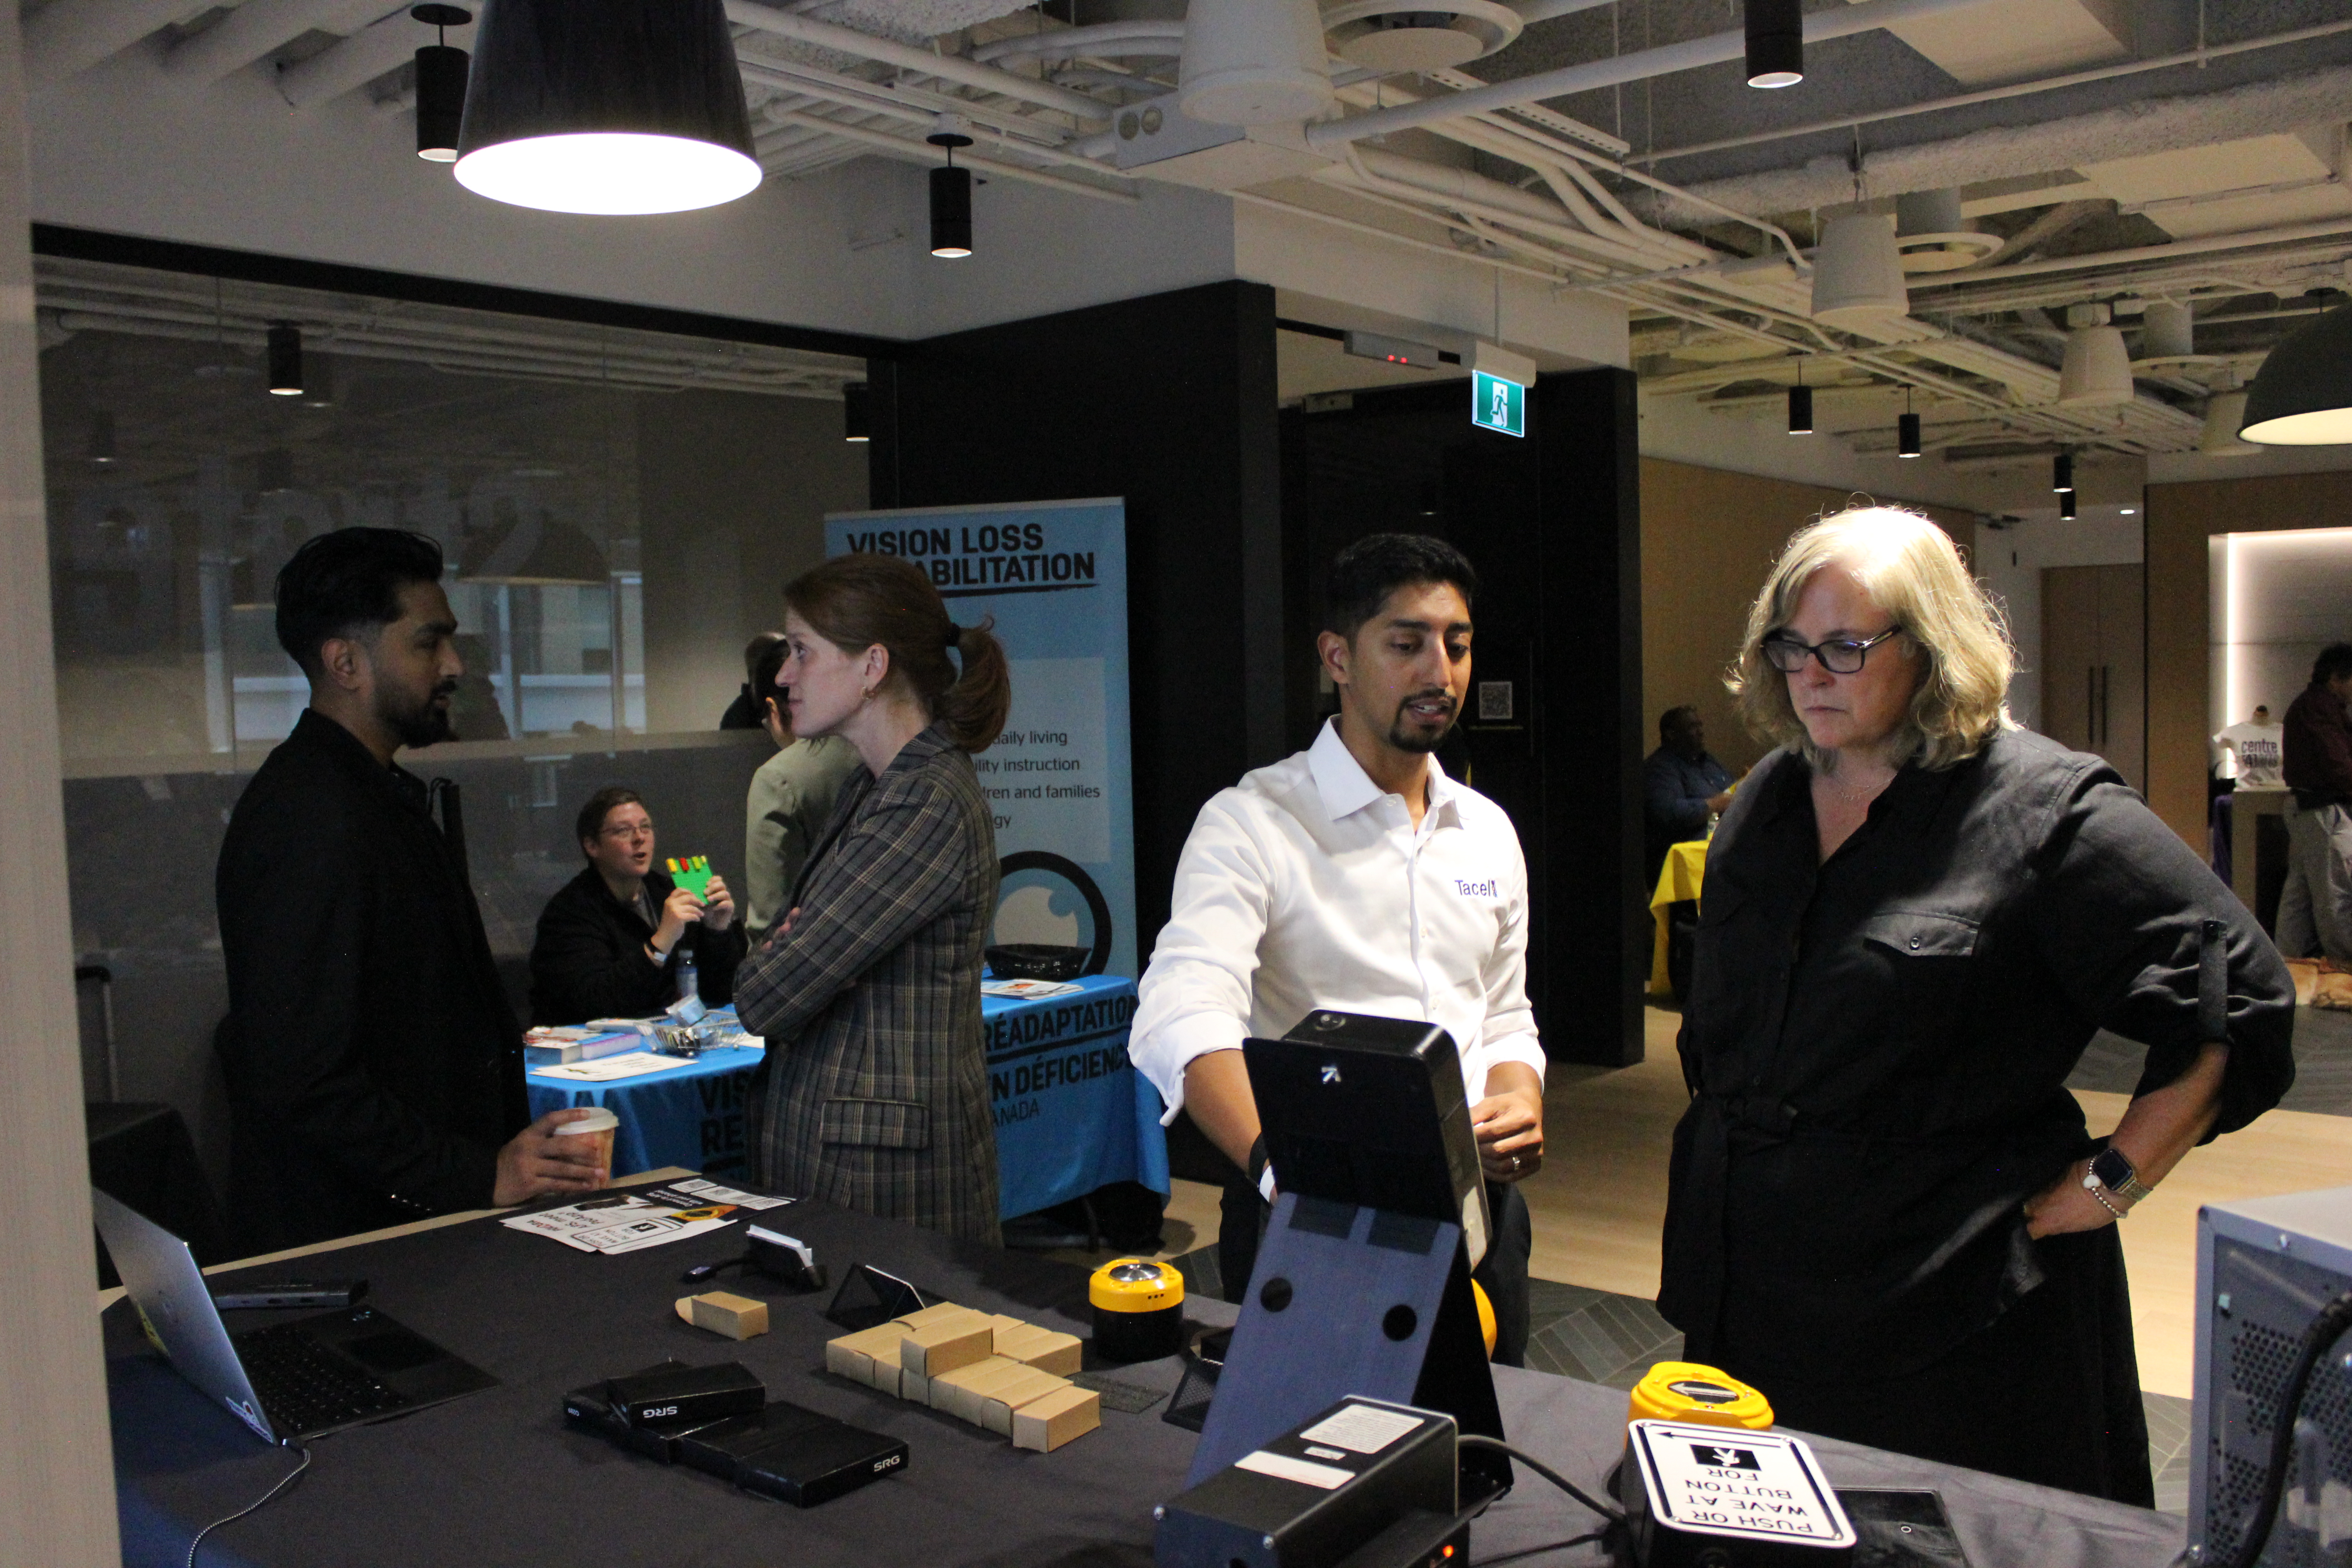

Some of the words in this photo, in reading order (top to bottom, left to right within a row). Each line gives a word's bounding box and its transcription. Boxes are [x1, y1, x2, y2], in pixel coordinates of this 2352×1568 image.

[847, 528, 951, 556] VISION
[962, 523, 1043, 554] LOSS
[1029, 731, 1067, 746] living
[2241, 739, 2277, 753] centre
[1004, 758, 1080, 772] instruction
[1014, 786, 1041, 799] and
[1046, 785, 1101, 799] families
[1015, 1042, 1126, 1095] DÉFICIENC
[993, 1098, 1039, 1126] NADA
[643, 1406, 678, 1418] SRG
[873, 1455, 900, 1472] SRG
[1706, 1468, 1759, 1481] FOR
[1685, 1480, 1792, 1499] BUTTON
[1686, 1495, 1718, 1506] AT
[1729, 1499, 1808, 1516] WAVE
[1691, 1511, 1728, 1523] OR
[1738, 1515, 1813, 1533] PUSH
